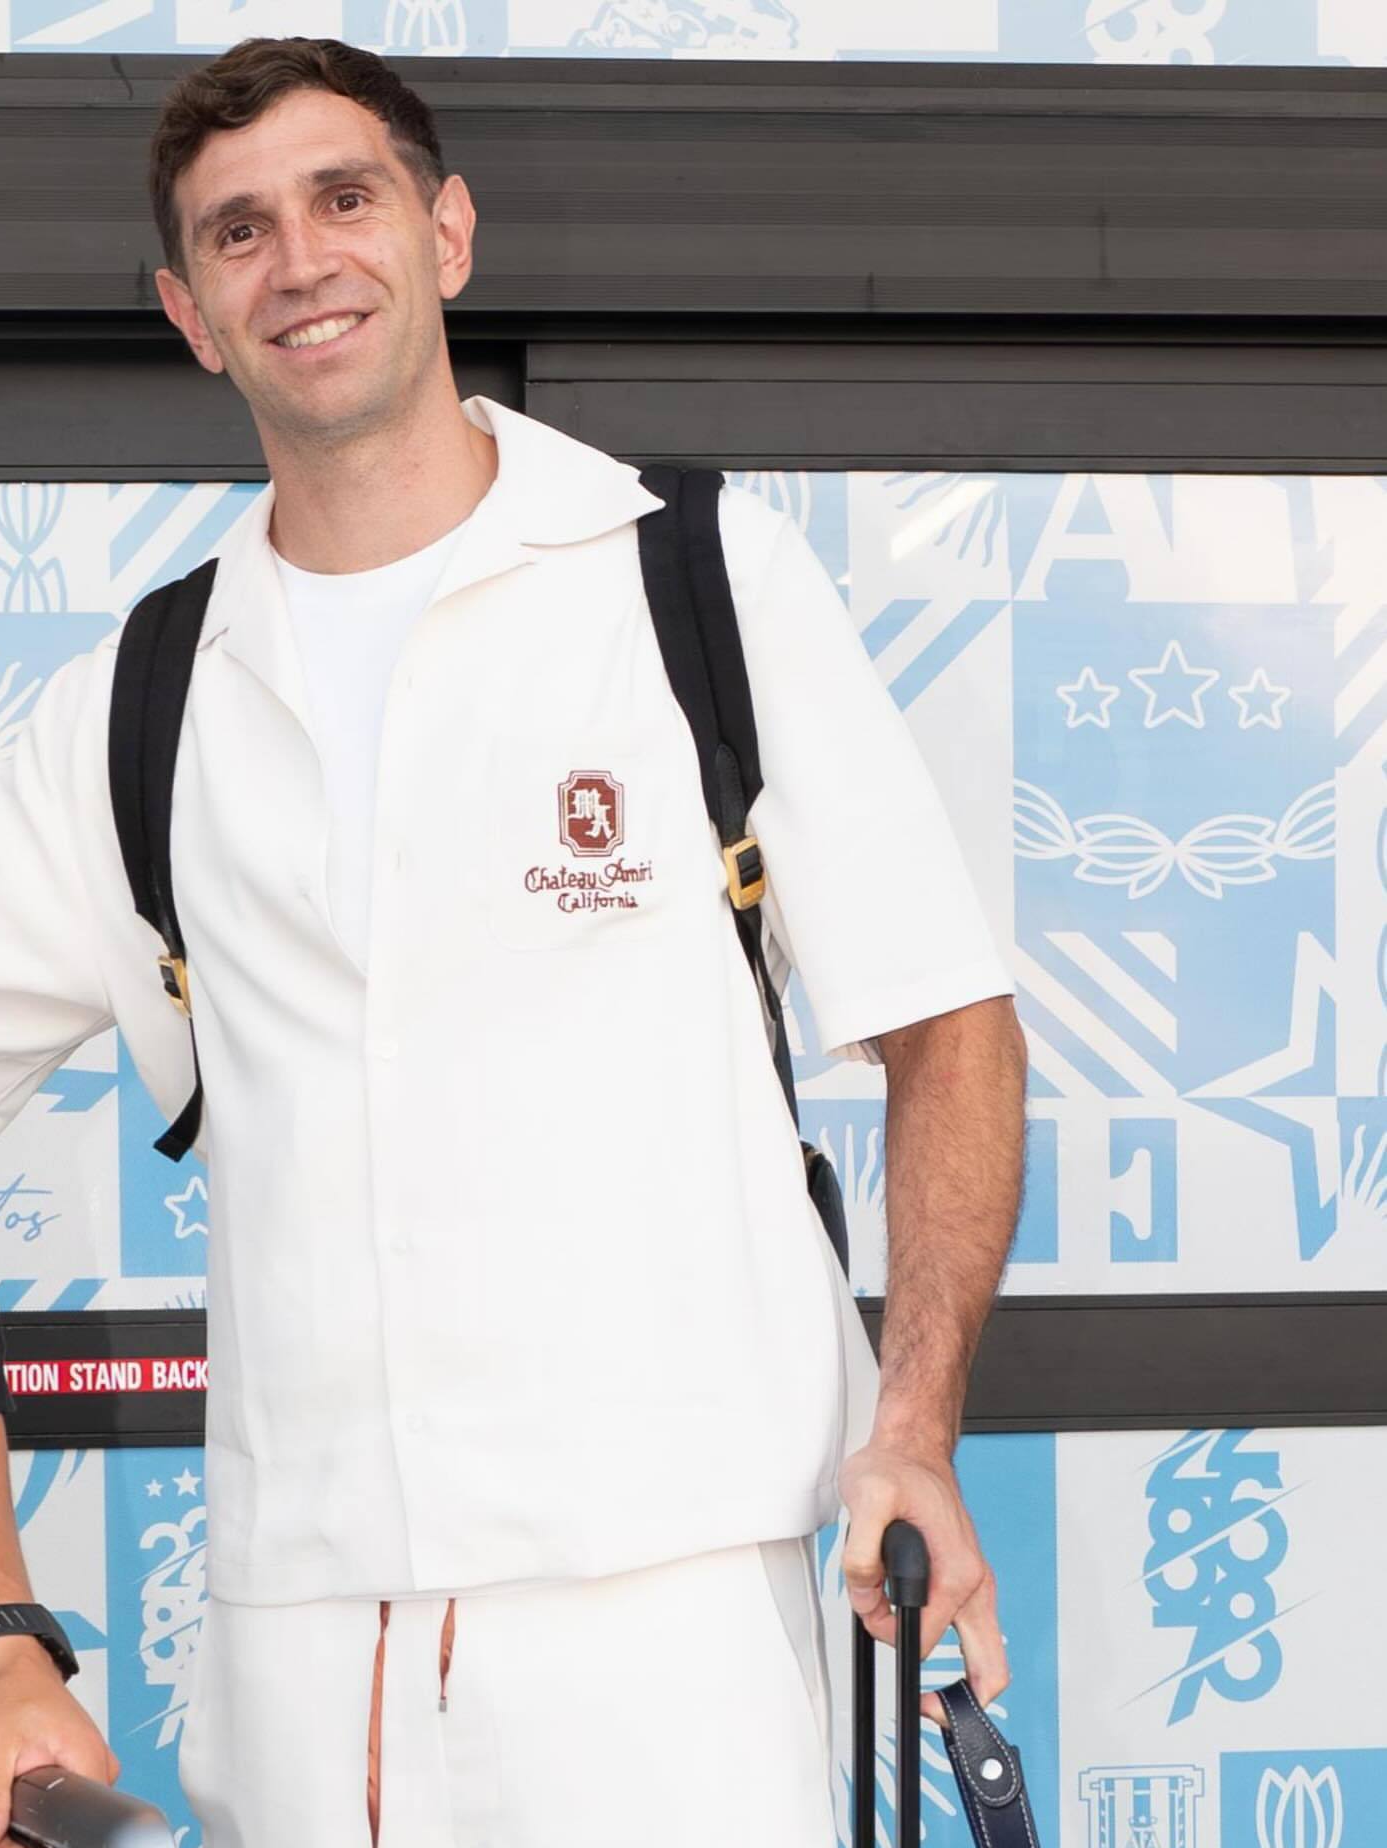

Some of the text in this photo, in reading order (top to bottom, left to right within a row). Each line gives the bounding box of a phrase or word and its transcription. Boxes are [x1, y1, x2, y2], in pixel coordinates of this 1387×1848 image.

[525, 864, 597, 893] Chateau
[558, 890, 638, 913] California
[69, 1362, 142, 1391] STAND
[152, 1360, 209, 1390] BACK
